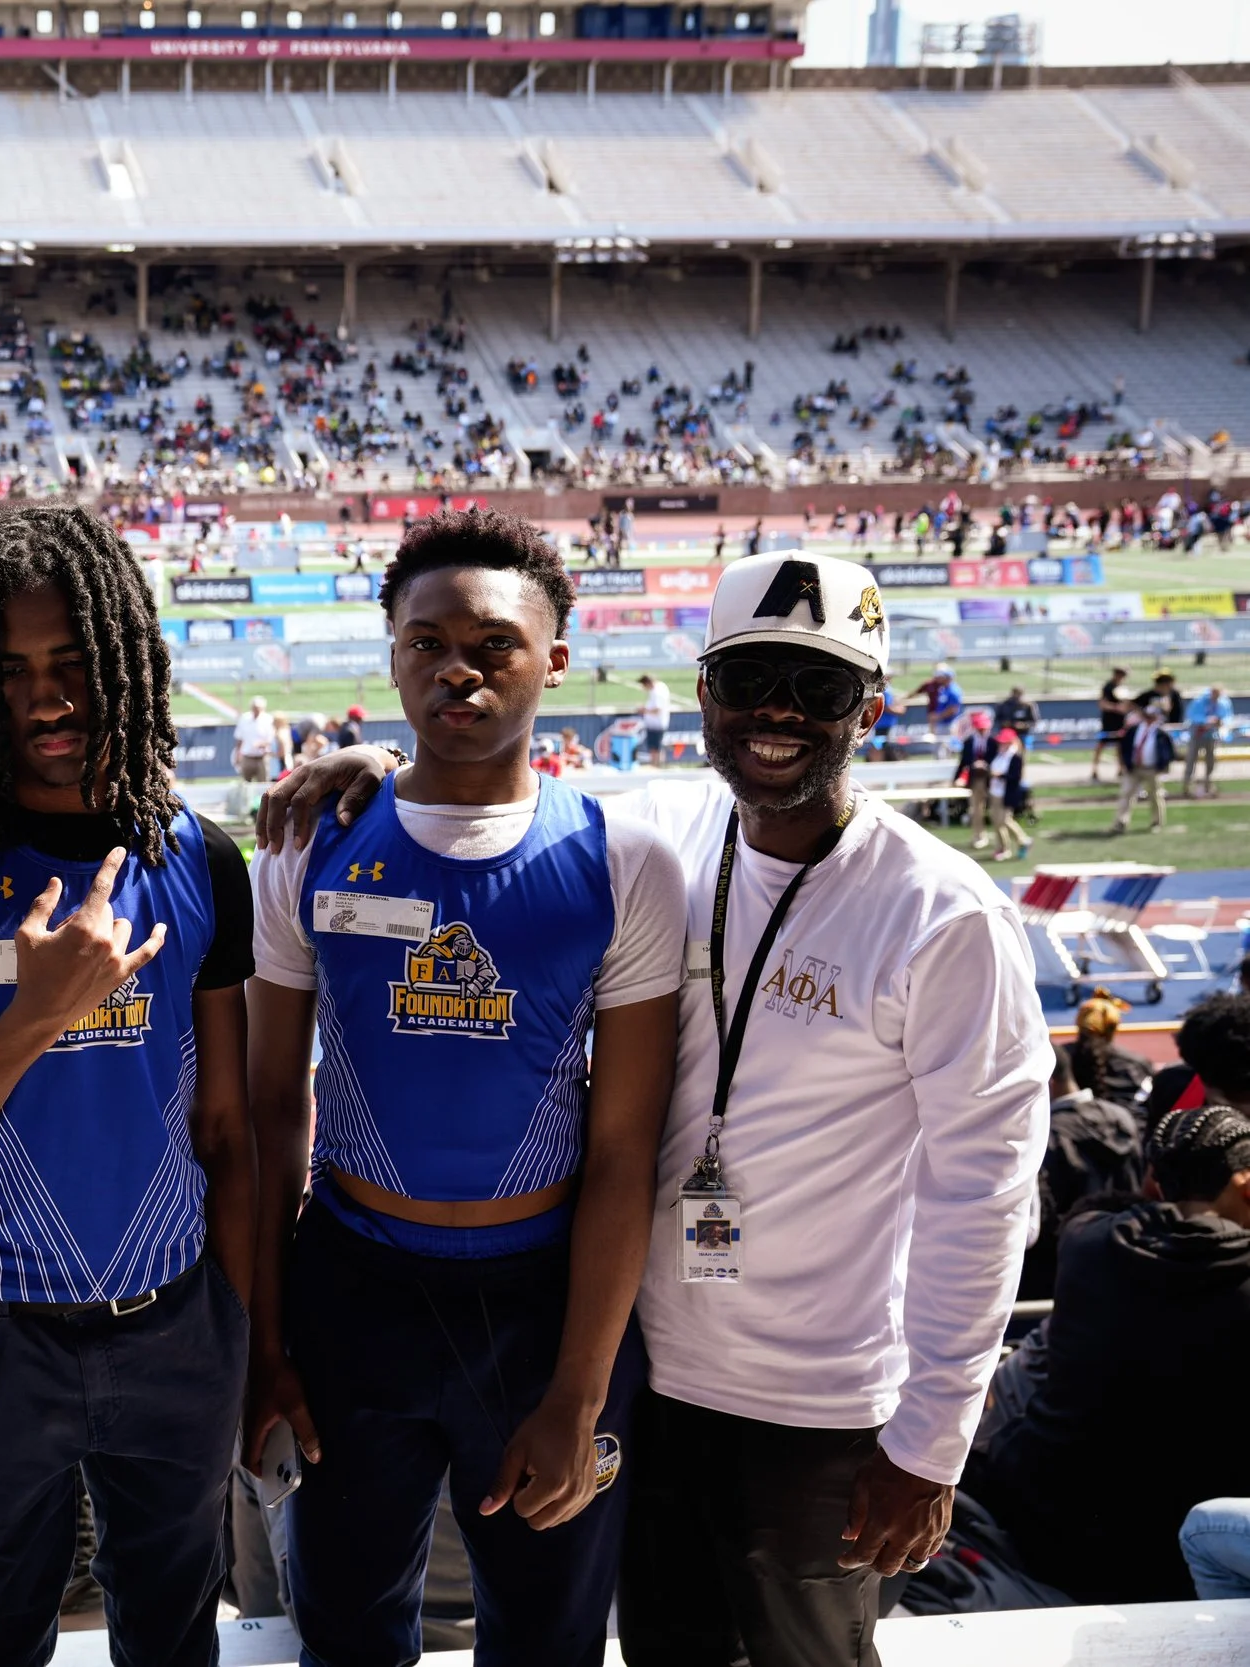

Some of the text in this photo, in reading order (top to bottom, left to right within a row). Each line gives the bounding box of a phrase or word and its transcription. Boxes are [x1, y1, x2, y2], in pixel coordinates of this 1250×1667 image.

[150, 40, 411, 56] UNIVERSITY OF PENNSYLVANIA
[714, 843, 733, 934] ALPHA PHI ALPHA
[416, 963, 451, 981] F A
[395, 988, 508, 1021] FOUNDATION
[408, 1016, 494, 1029] ACADEMIES
[58, 1028, 138, 1042] ACADEMIES
[595, 1455, 618, 1470] DATION
[596, 1464, 614, 1476] DEMY
